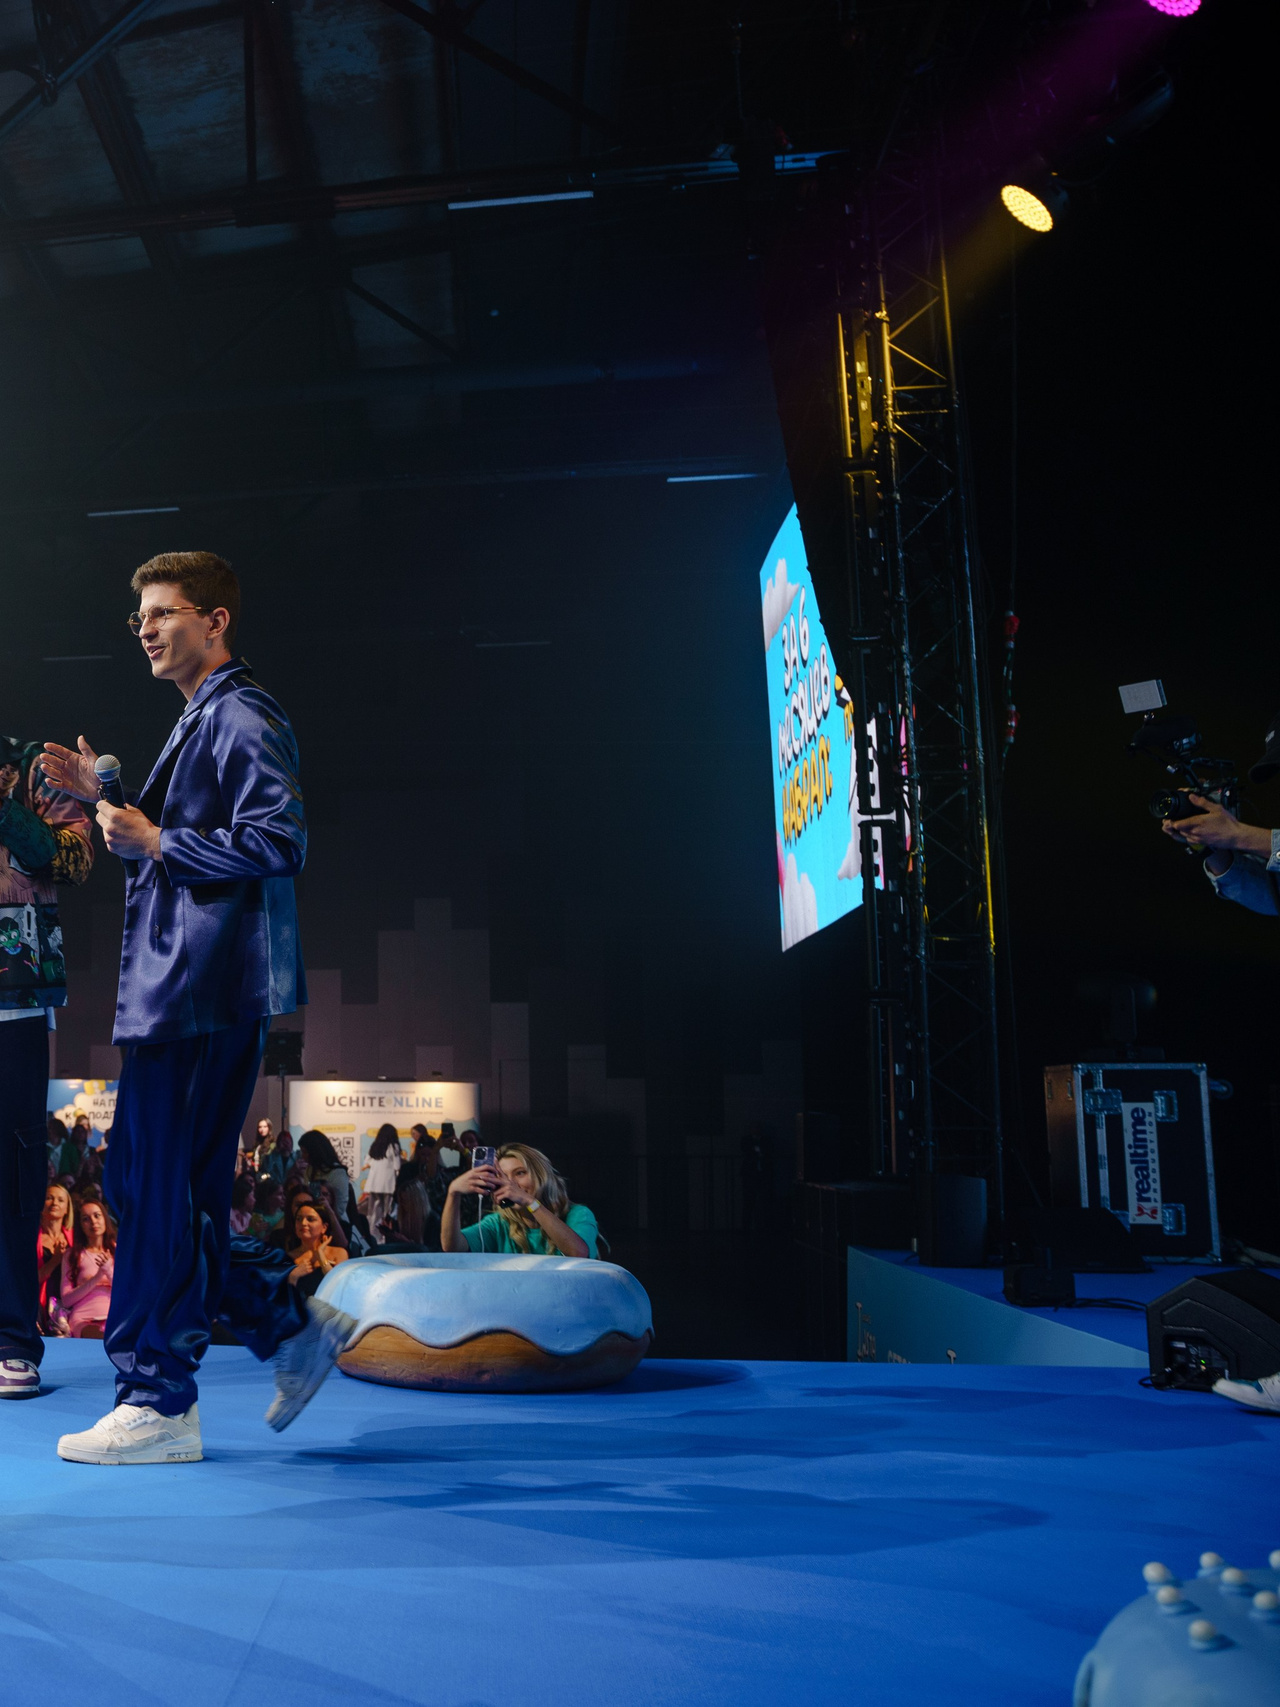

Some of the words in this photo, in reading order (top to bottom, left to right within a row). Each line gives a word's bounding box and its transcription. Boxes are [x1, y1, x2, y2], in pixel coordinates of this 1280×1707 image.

[782, 612, 799, 696] ЗА
[799, 585, 810, 668] 6
[1127, 1107, 1152, 1203] realtime
[1147, 1111, 1158, 1204] PRODUCTION
